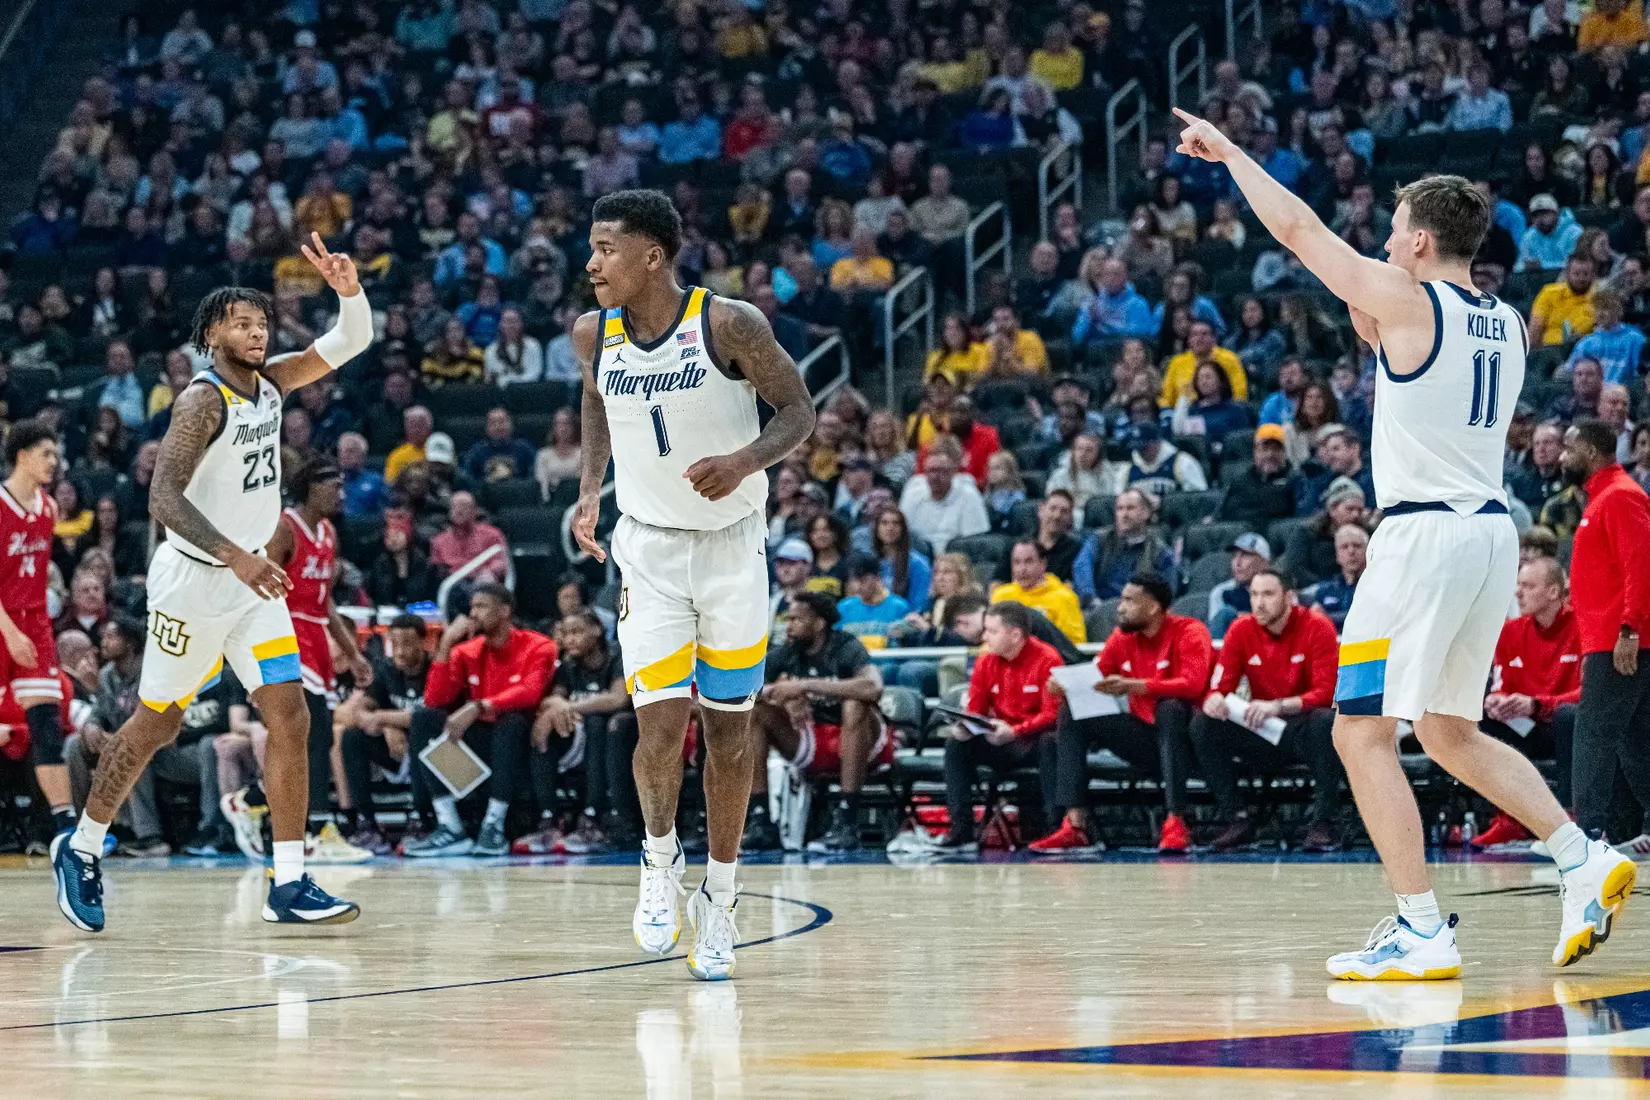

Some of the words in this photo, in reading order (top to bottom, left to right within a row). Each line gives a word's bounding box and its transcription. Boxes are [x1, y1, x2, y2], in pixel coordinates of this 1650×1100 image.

[1467, 313, 1507, 342] KOLEK
[603, 361, 707, 401] Marquette
[1467, 349, 1501, 428] 11
[650, 405, 672, 457] 1
[243, 444, 277, 494] 23
[152, 610, 191, 657] MU
